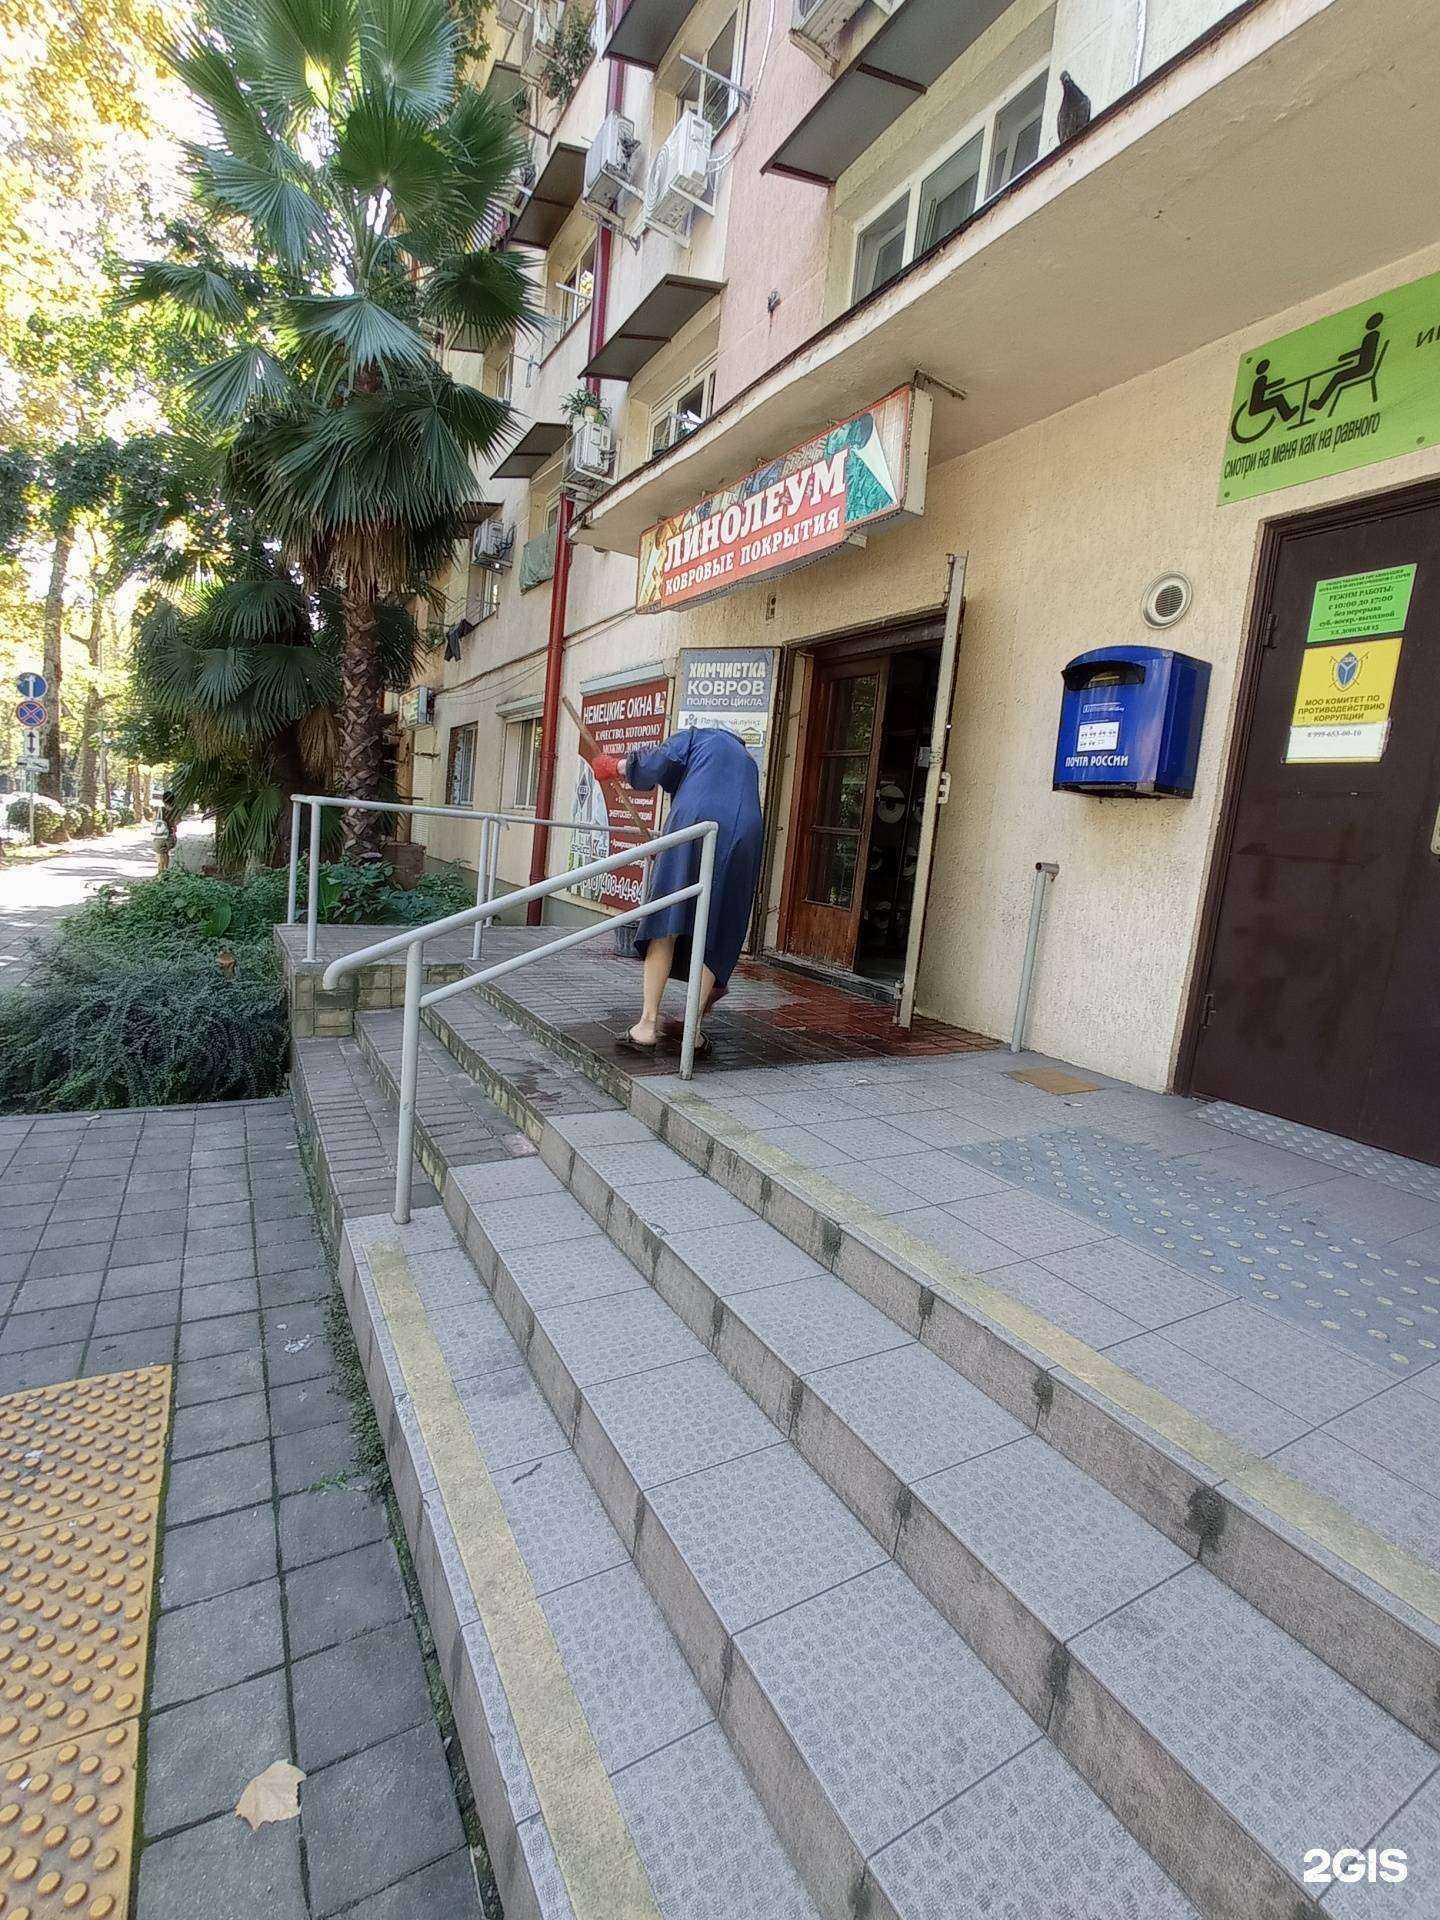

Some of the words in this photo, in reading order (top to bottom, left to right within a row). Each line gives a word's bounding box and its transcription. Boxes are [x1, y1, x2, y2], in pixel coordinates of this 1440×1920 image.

[1224, 456, 1257, 479] смотри
[1257, 449, 1270, 467] на
[1271, 436, 1299, 465] меня
[1299, 428, 1318, 456] как
[1318, 427, 1332, 449] на
[1332, 412, 1381, 453] равного
[664, 449, 849, 572] ЛИНОЛЕУМ
[665, 552, 734, 597] КОВРОВЫЕ
[739, 506, 841, 565] ПОКРЫТИЯ
[1328, 591, 1358, 602] РЕЖИМ
[1334, 600, 1357, 610] 10:00
[1370, 595, 1394, 605] 17:00
[688, 662, 766, 678] ХИМЧИСТКА
[687, 680, 765, 695] КОВРОВ
[687, 698, 730, 706] ПОЛНОГО
[730, 697, 762, 707] ЦИКЛА
[1325, 696, 1364, 705] КОМИТЕТ
[583, 700, 626, 725] НЕМЕЦКИЕ
[627, 694, 653, 718] ОКНА
[1298, 703, 1385, 715] ПРОТИВОДЕЙСТВИЮ
[1313, 713, 1365, 722] КОРРУПЦИИ
[625, 723, 662, 738] КОТОРОМУ
[1065, 756, 1089, 768] ПОЧТА
[1090, 755, 1129, 767] РОССИИ
